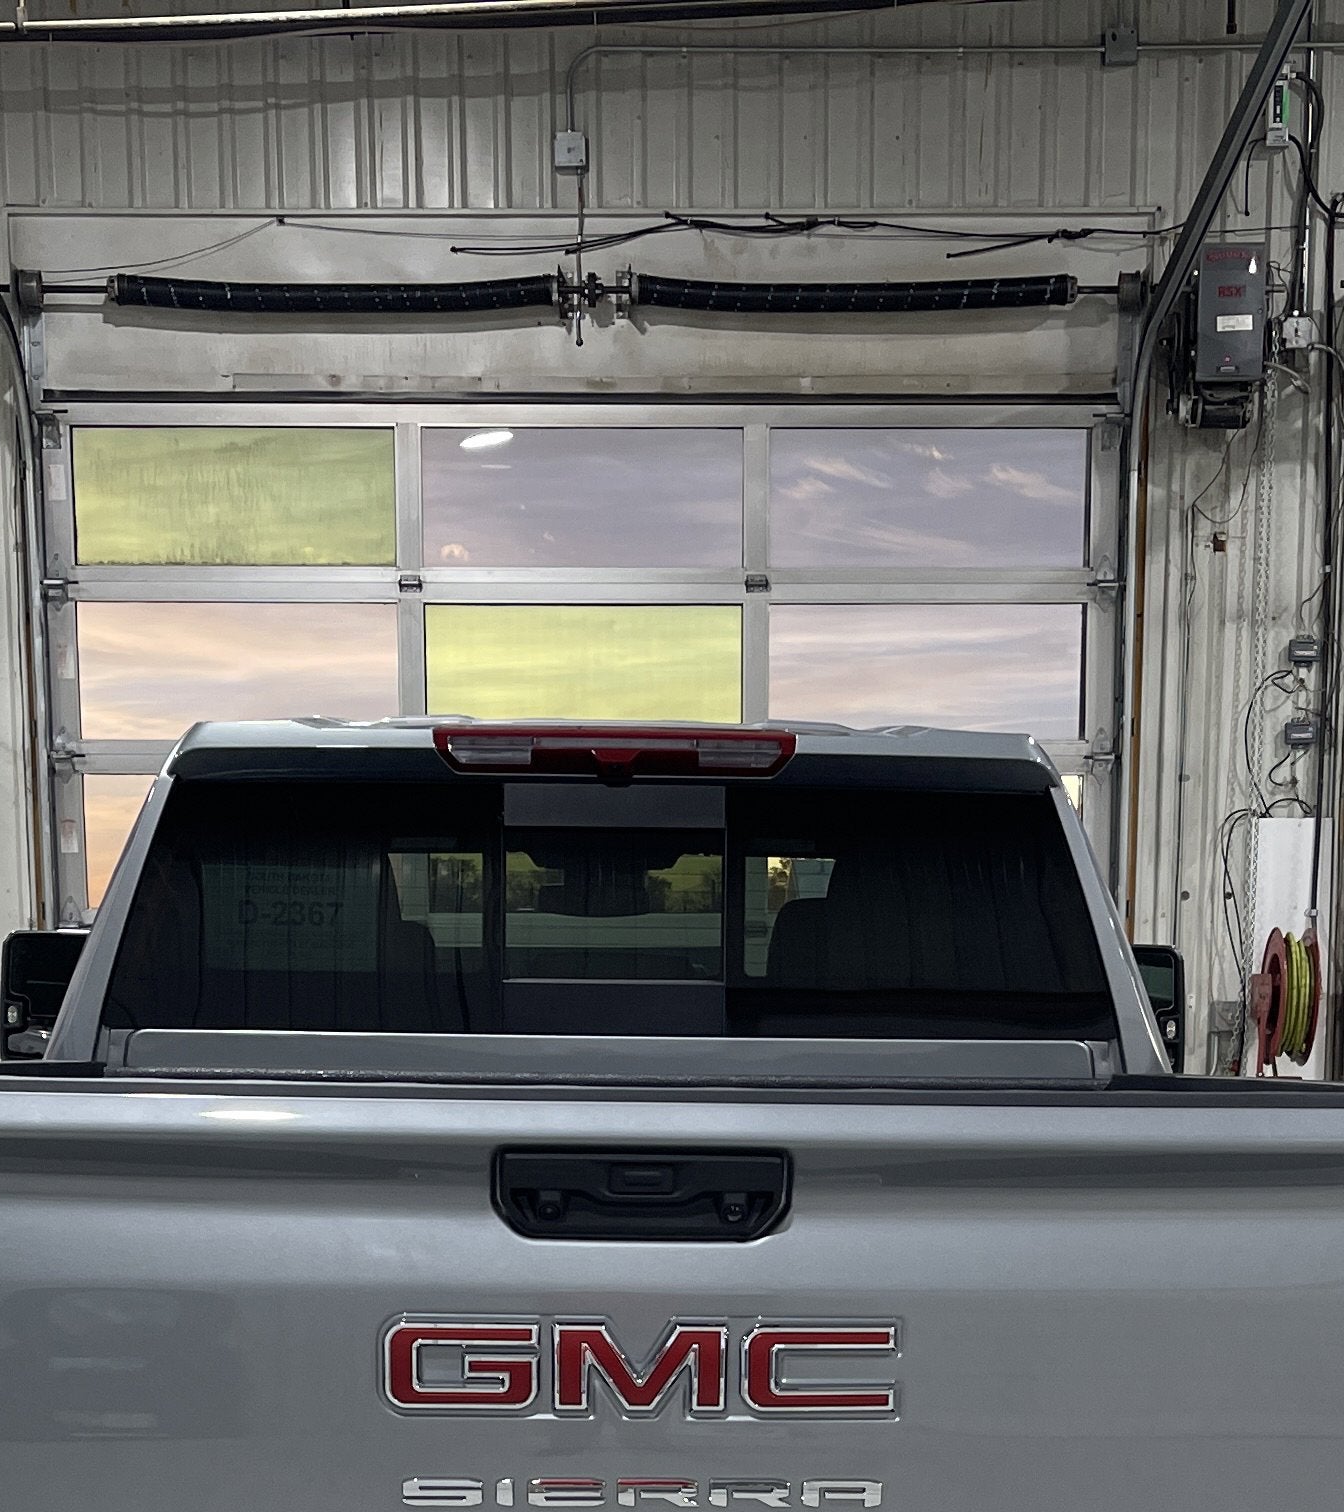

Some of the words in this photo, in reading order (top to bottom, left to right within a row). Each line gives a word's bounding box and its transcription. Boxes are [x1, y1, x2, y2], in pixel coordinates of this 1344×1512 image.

[238, 899, 344, 926] D-2367
[382, 1321, 897, 1414] GMC
[402, 1477, 883, 1508] SIERRA
